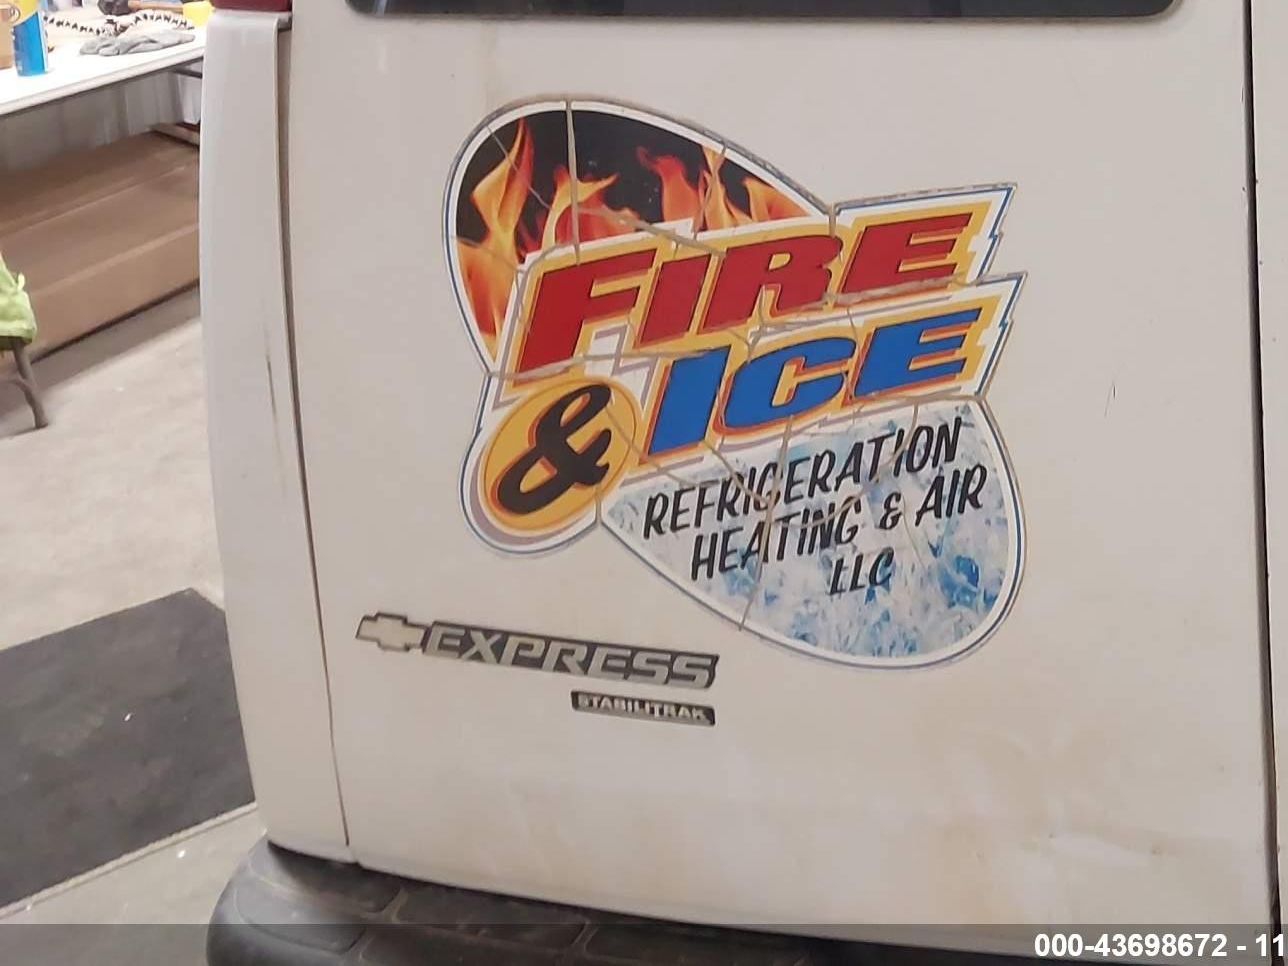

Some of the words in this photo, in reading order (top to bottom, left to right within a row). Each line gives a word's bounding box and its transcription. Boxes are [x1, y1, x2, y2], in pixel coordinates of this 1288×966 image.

[512, 213, 973, 382] FIRE
[497, 382, 612, 515] &
[644, 307, 983, 457] ICE
[644, 417, 962, 538] REFRIGERATION
[691, 498, 861, 580] HEATING
[880, 492, 902, 530] &
[916, 465, 988, 527] AIR
[828, 547, 895, 595] LLC
[423, 624, 716, 689] EXPRESS
[577, 692, 712, 723] STABILITRAK
